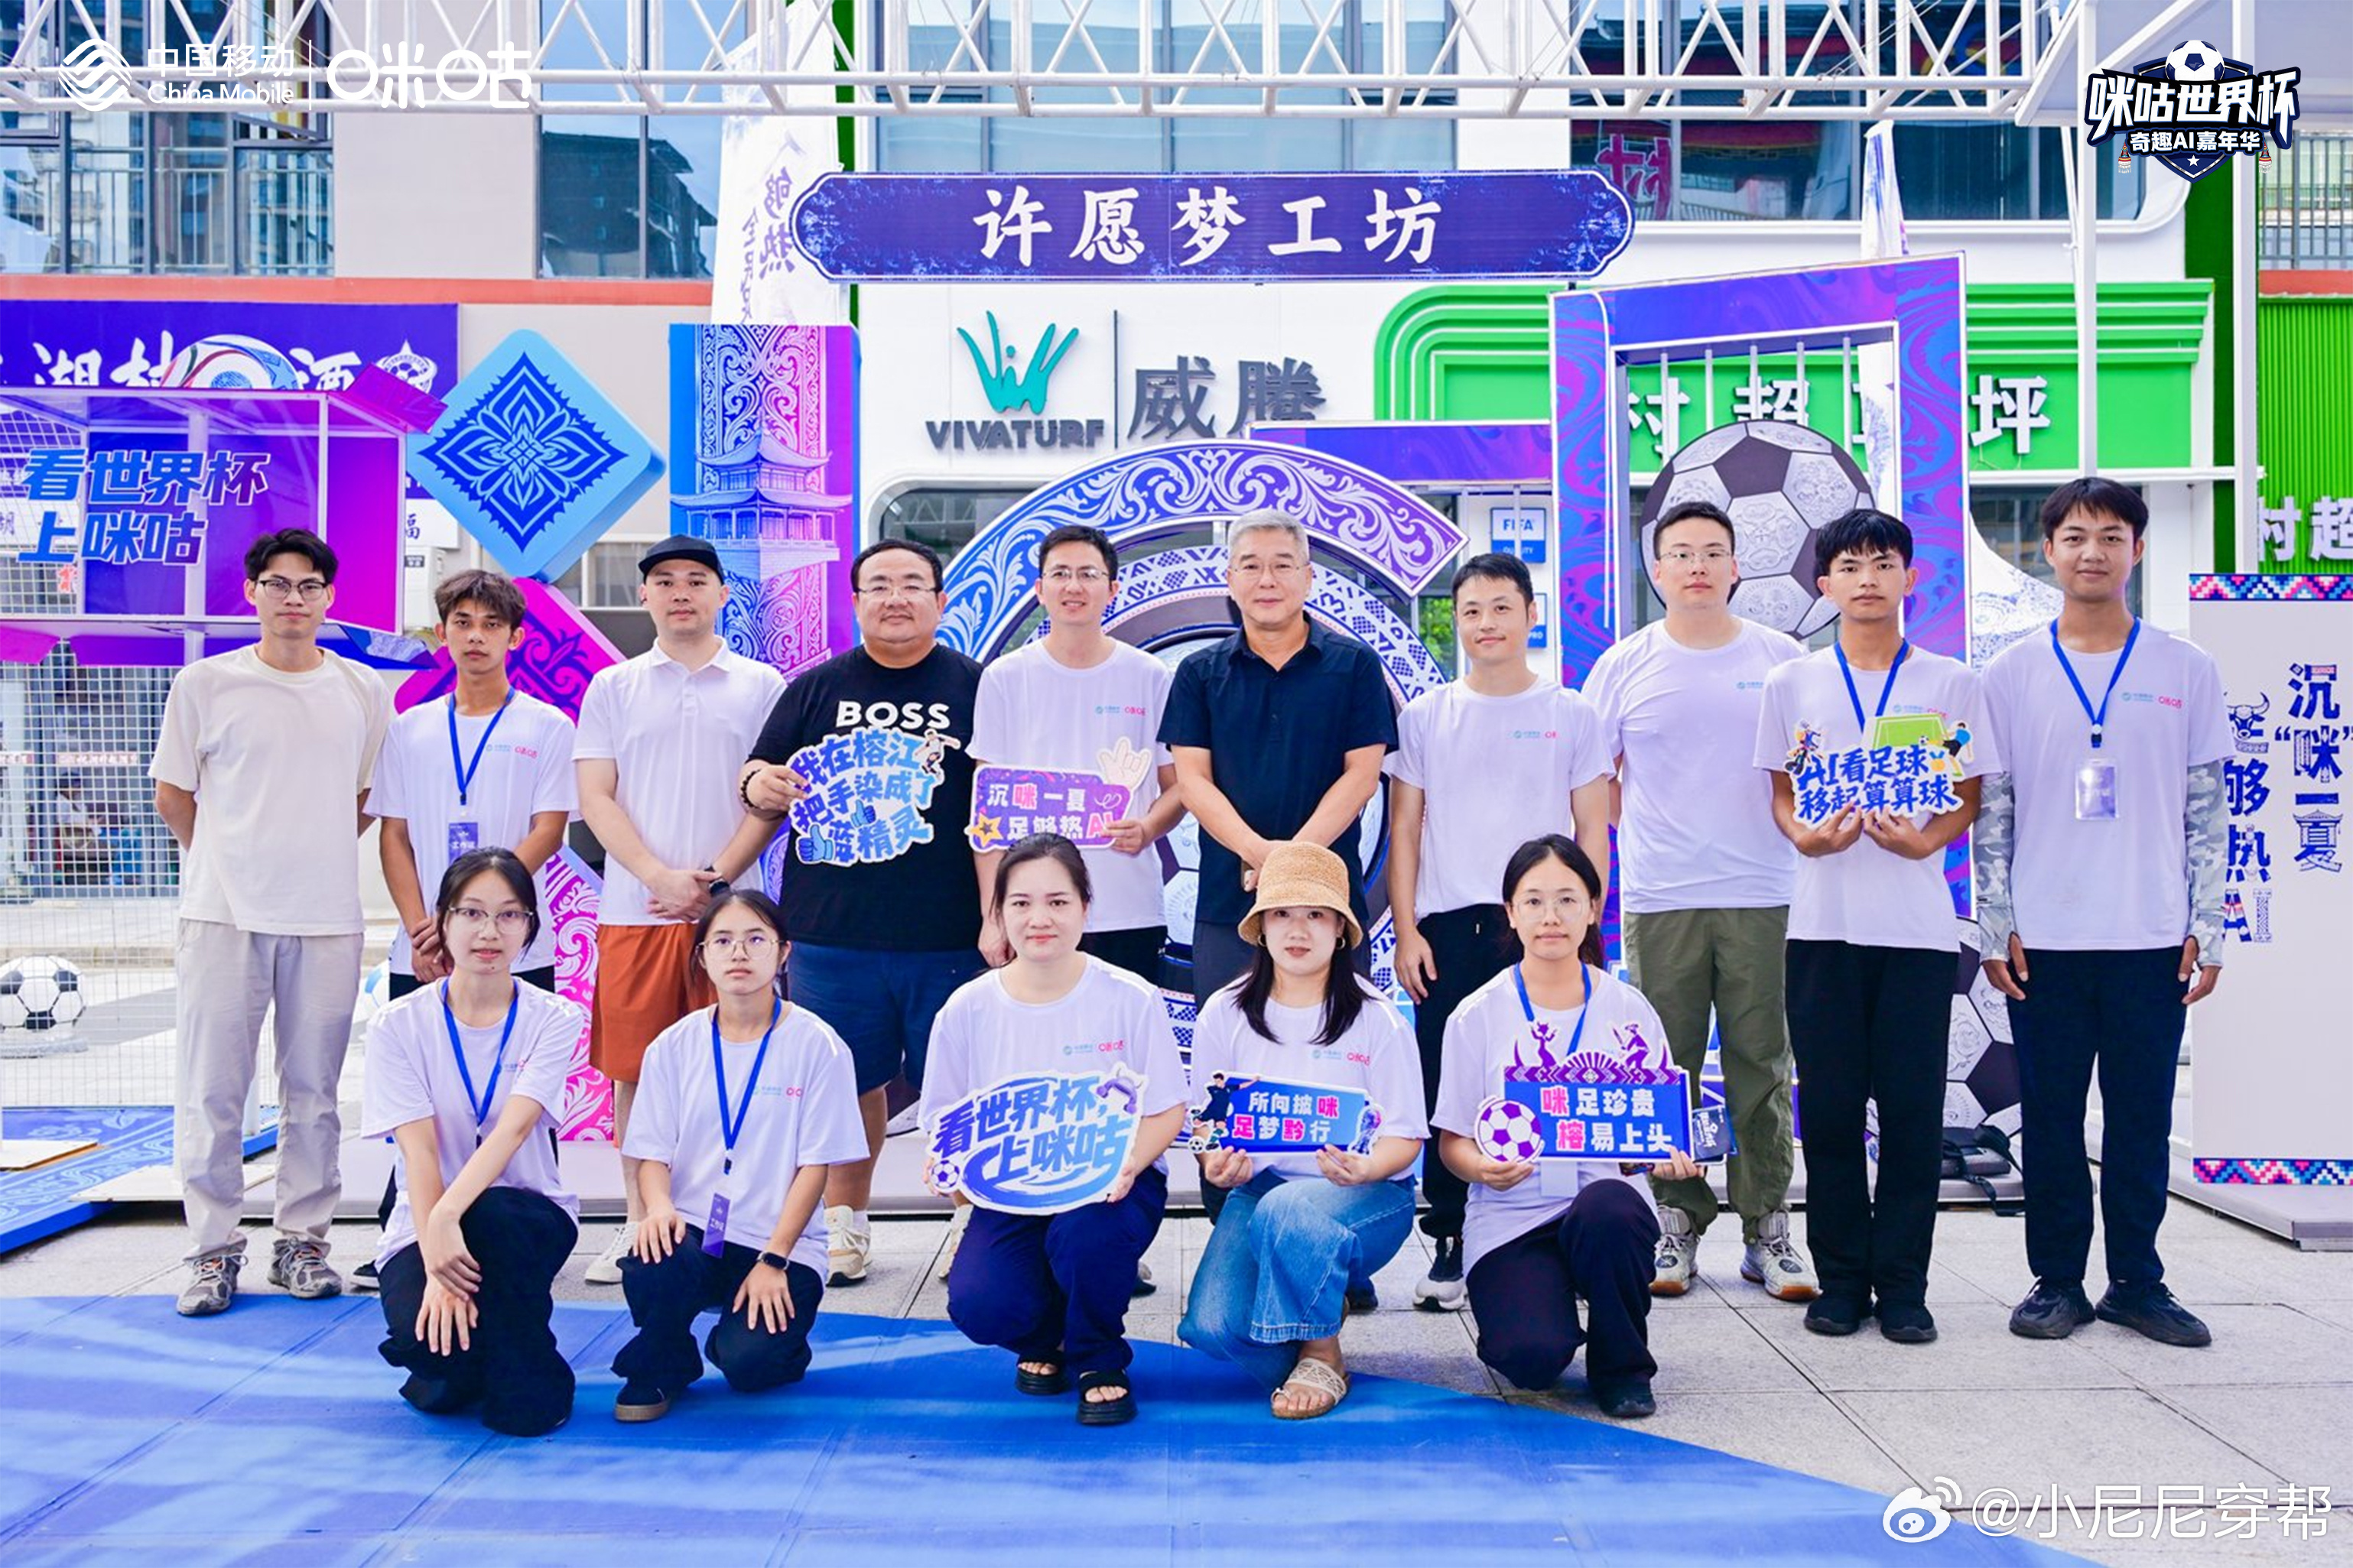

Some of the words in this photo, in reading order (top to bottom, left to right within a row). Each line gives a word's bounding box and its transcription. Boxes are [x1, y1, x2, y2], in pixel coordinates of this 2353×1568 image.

[973, 186, 1442, 267] 许愿梦工坊
[1127, 355, 1328, 439] 威腾
[925, 418, 1106, 452] VIVATURF
[20, 449, 271, 505] 看世界杯
[18, 511, 208, 565] 上咪咕
[836, 700, 951, 729] BOSS
[790, 729, 925, 794] 我在榕江
[1797, 744, 1929, 791] AI看足球
[793, 770, 936, 833] 把手染成了
[986, 783, 1087, 813] 沉咪一夏
[827, 804, 931, 863] 蓝精灵
[1248, 1091, 1340, 1119] 所向披咪
[1539, 1085, 1656, 1118] 咪足珍贵
[985, 1113, 1134, 1183] 上咪咕
[1231, 1113, 1331, 1143] 足梦黔行
[1556, 1118, 1674, 1153] 榕易上头
